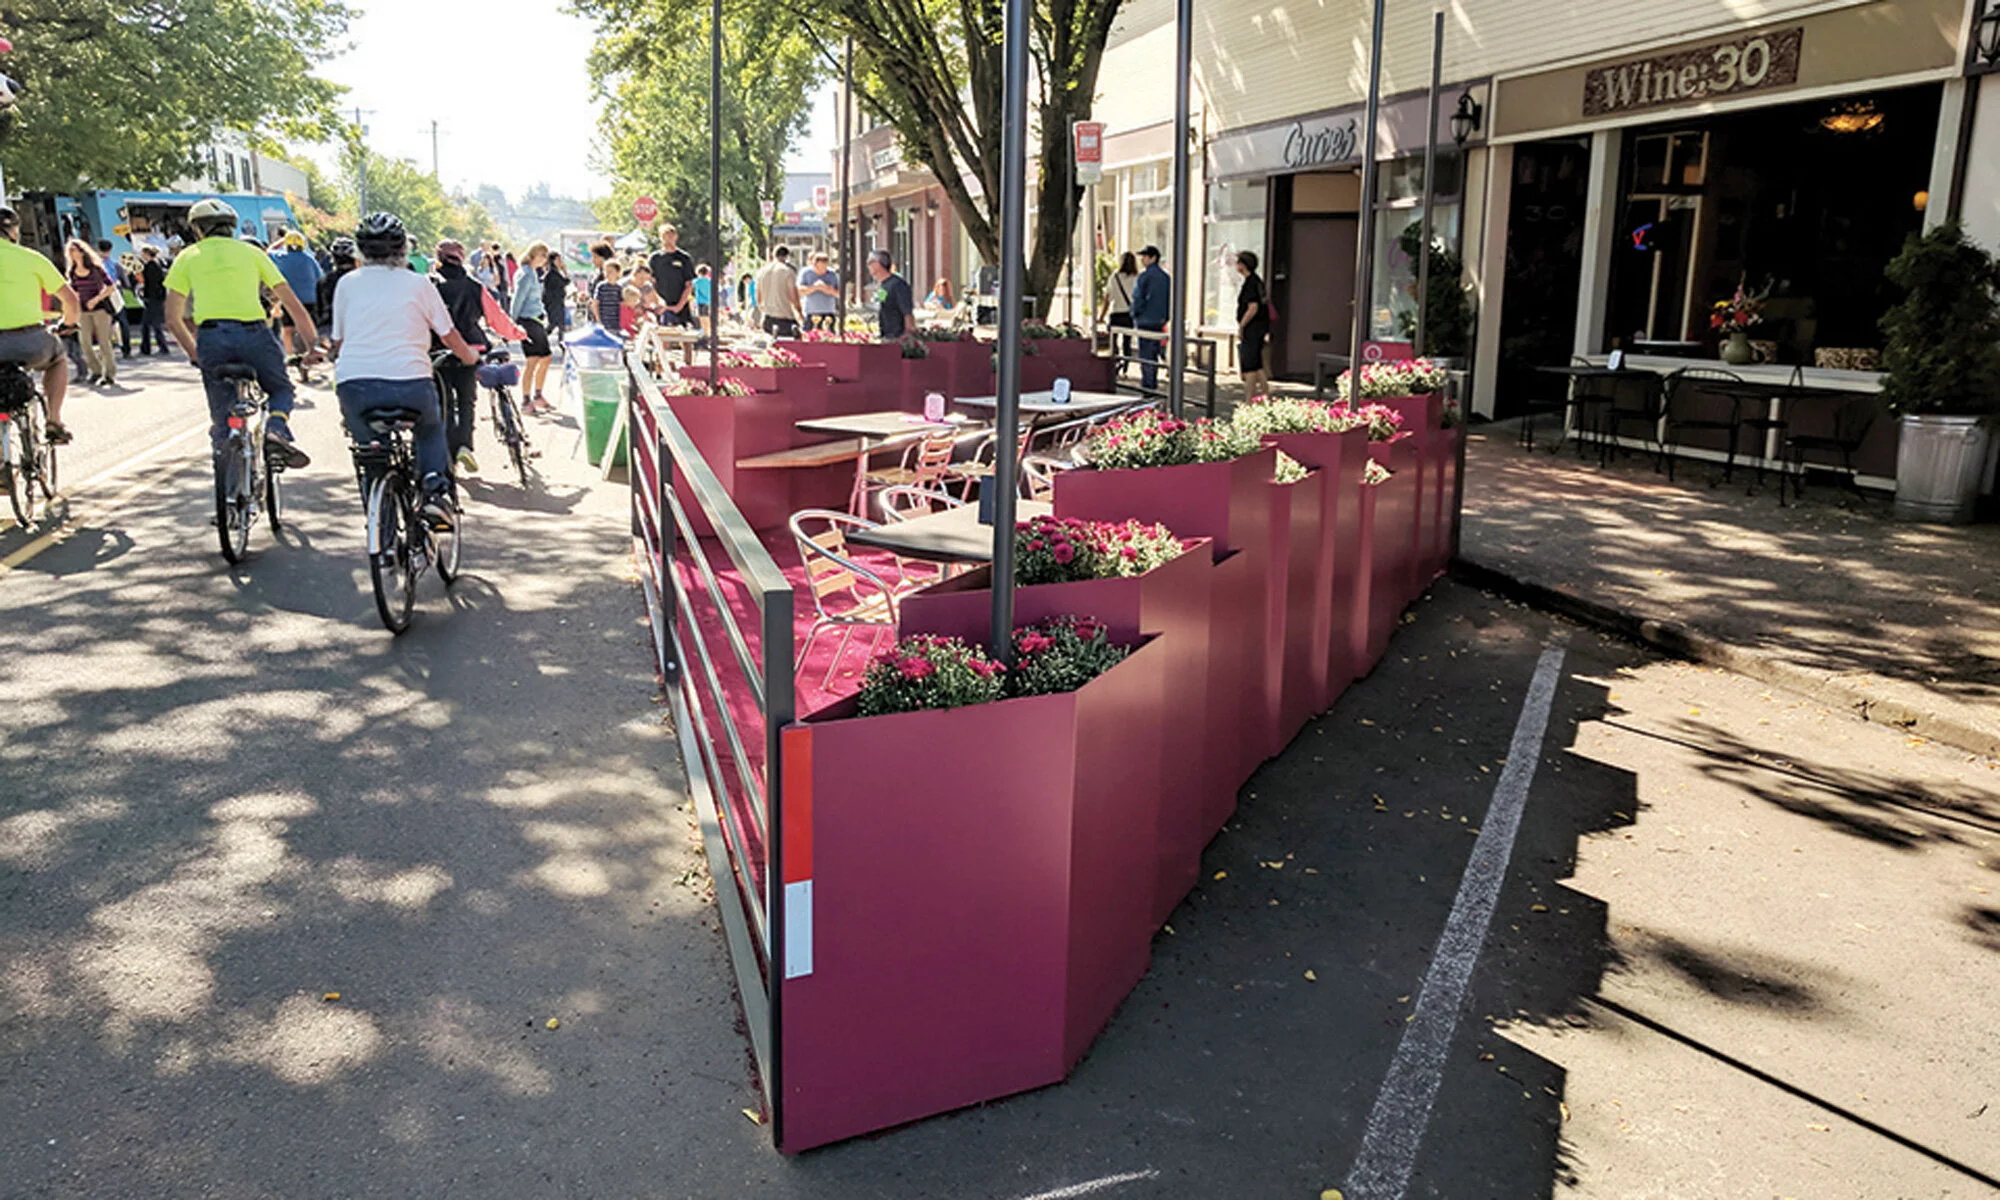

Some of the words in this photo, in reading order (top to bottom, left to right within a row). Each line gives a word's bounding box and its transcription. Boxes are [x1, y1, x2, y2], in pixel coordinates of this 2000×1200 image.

[1604, 38, 1770, 108] Wine:30
[1283, 119, 1357, 168] Curves
[634, 203, 657, 215] STOP
